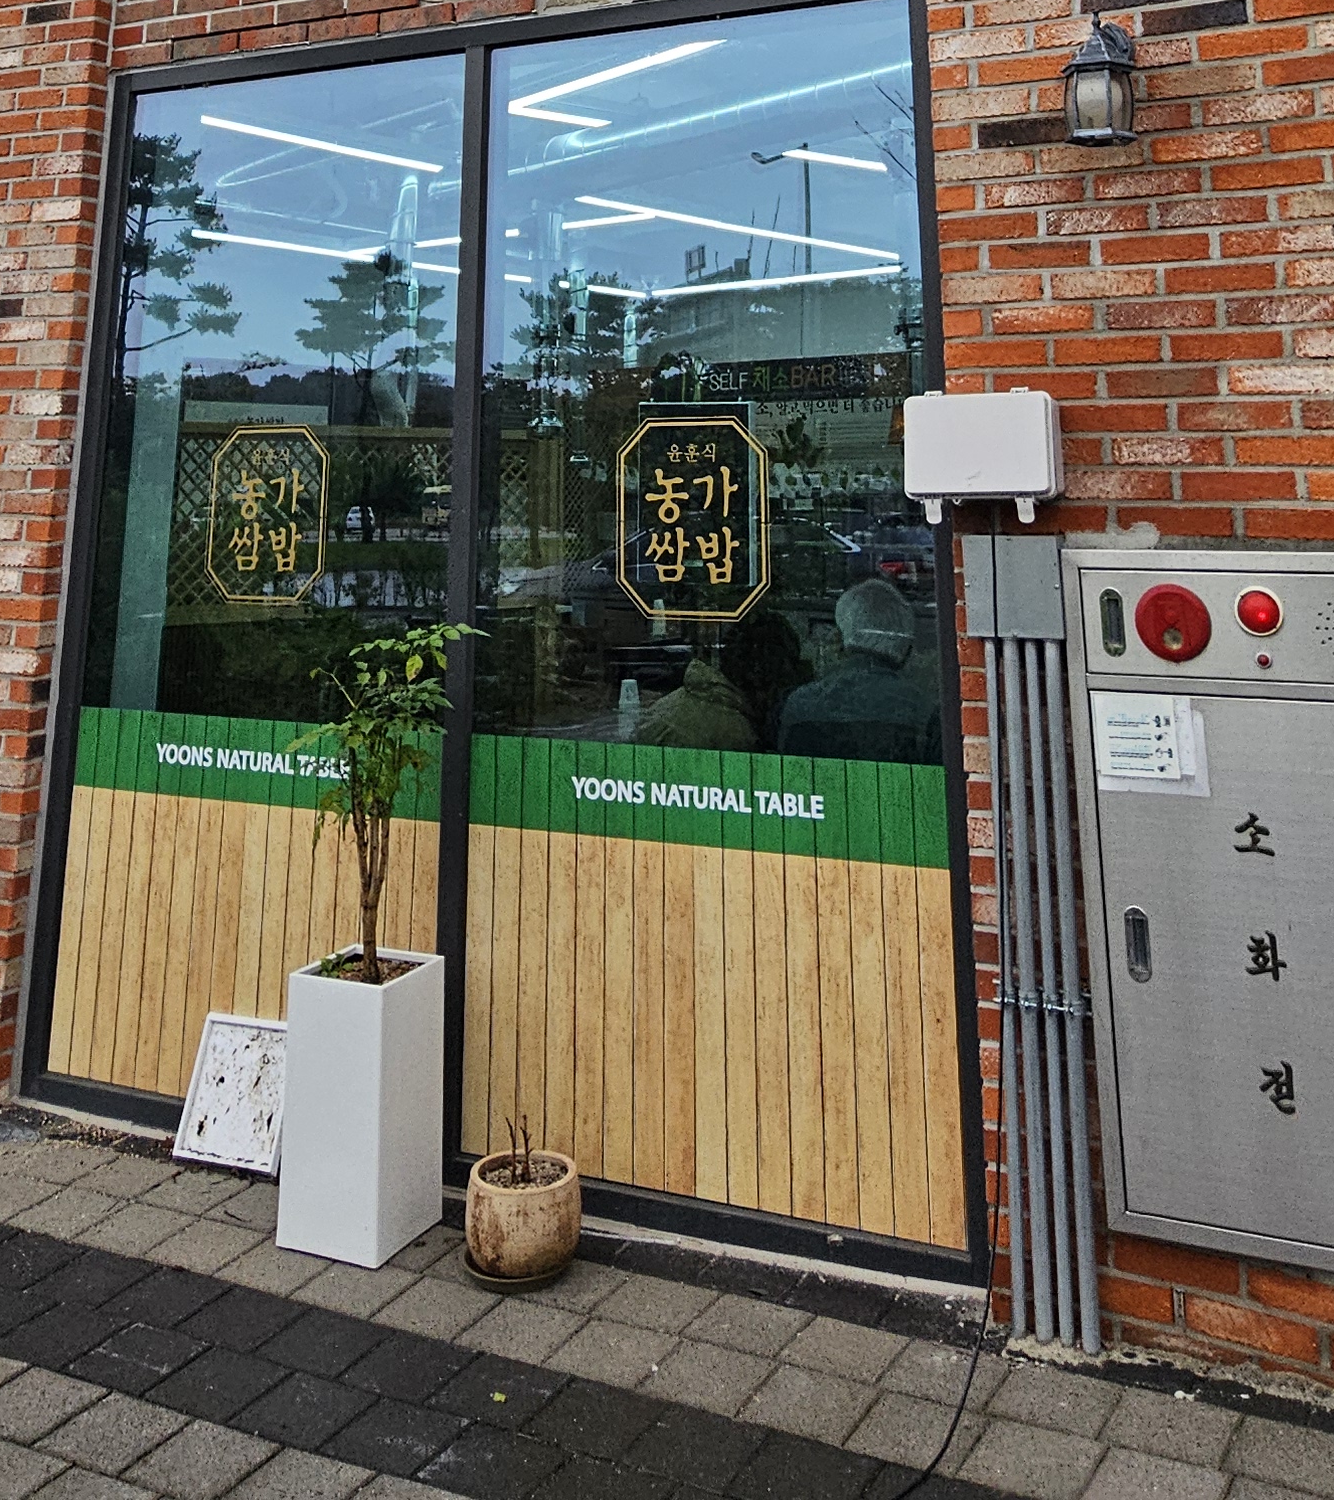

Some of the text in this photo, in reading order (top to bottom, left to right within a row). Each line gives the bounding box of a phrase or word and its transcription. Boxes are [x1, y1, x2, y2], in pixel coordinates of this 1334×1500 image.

[708, 371, 749, 392] SELF
[667, 443, 717, 463] 윤훈식
[232, 467, 305, 520] 농가
[644, 465, 739, 524] 농가
[228, 521, 303, 573] 쌈밥
[644, 525, 740, 585] 쌈밥
[156, 742, 213, 768] YOONS
[216, 747, 294, 775] NATURAL
[571, 776, 825, 819] YOONS NATURAL TABLE
